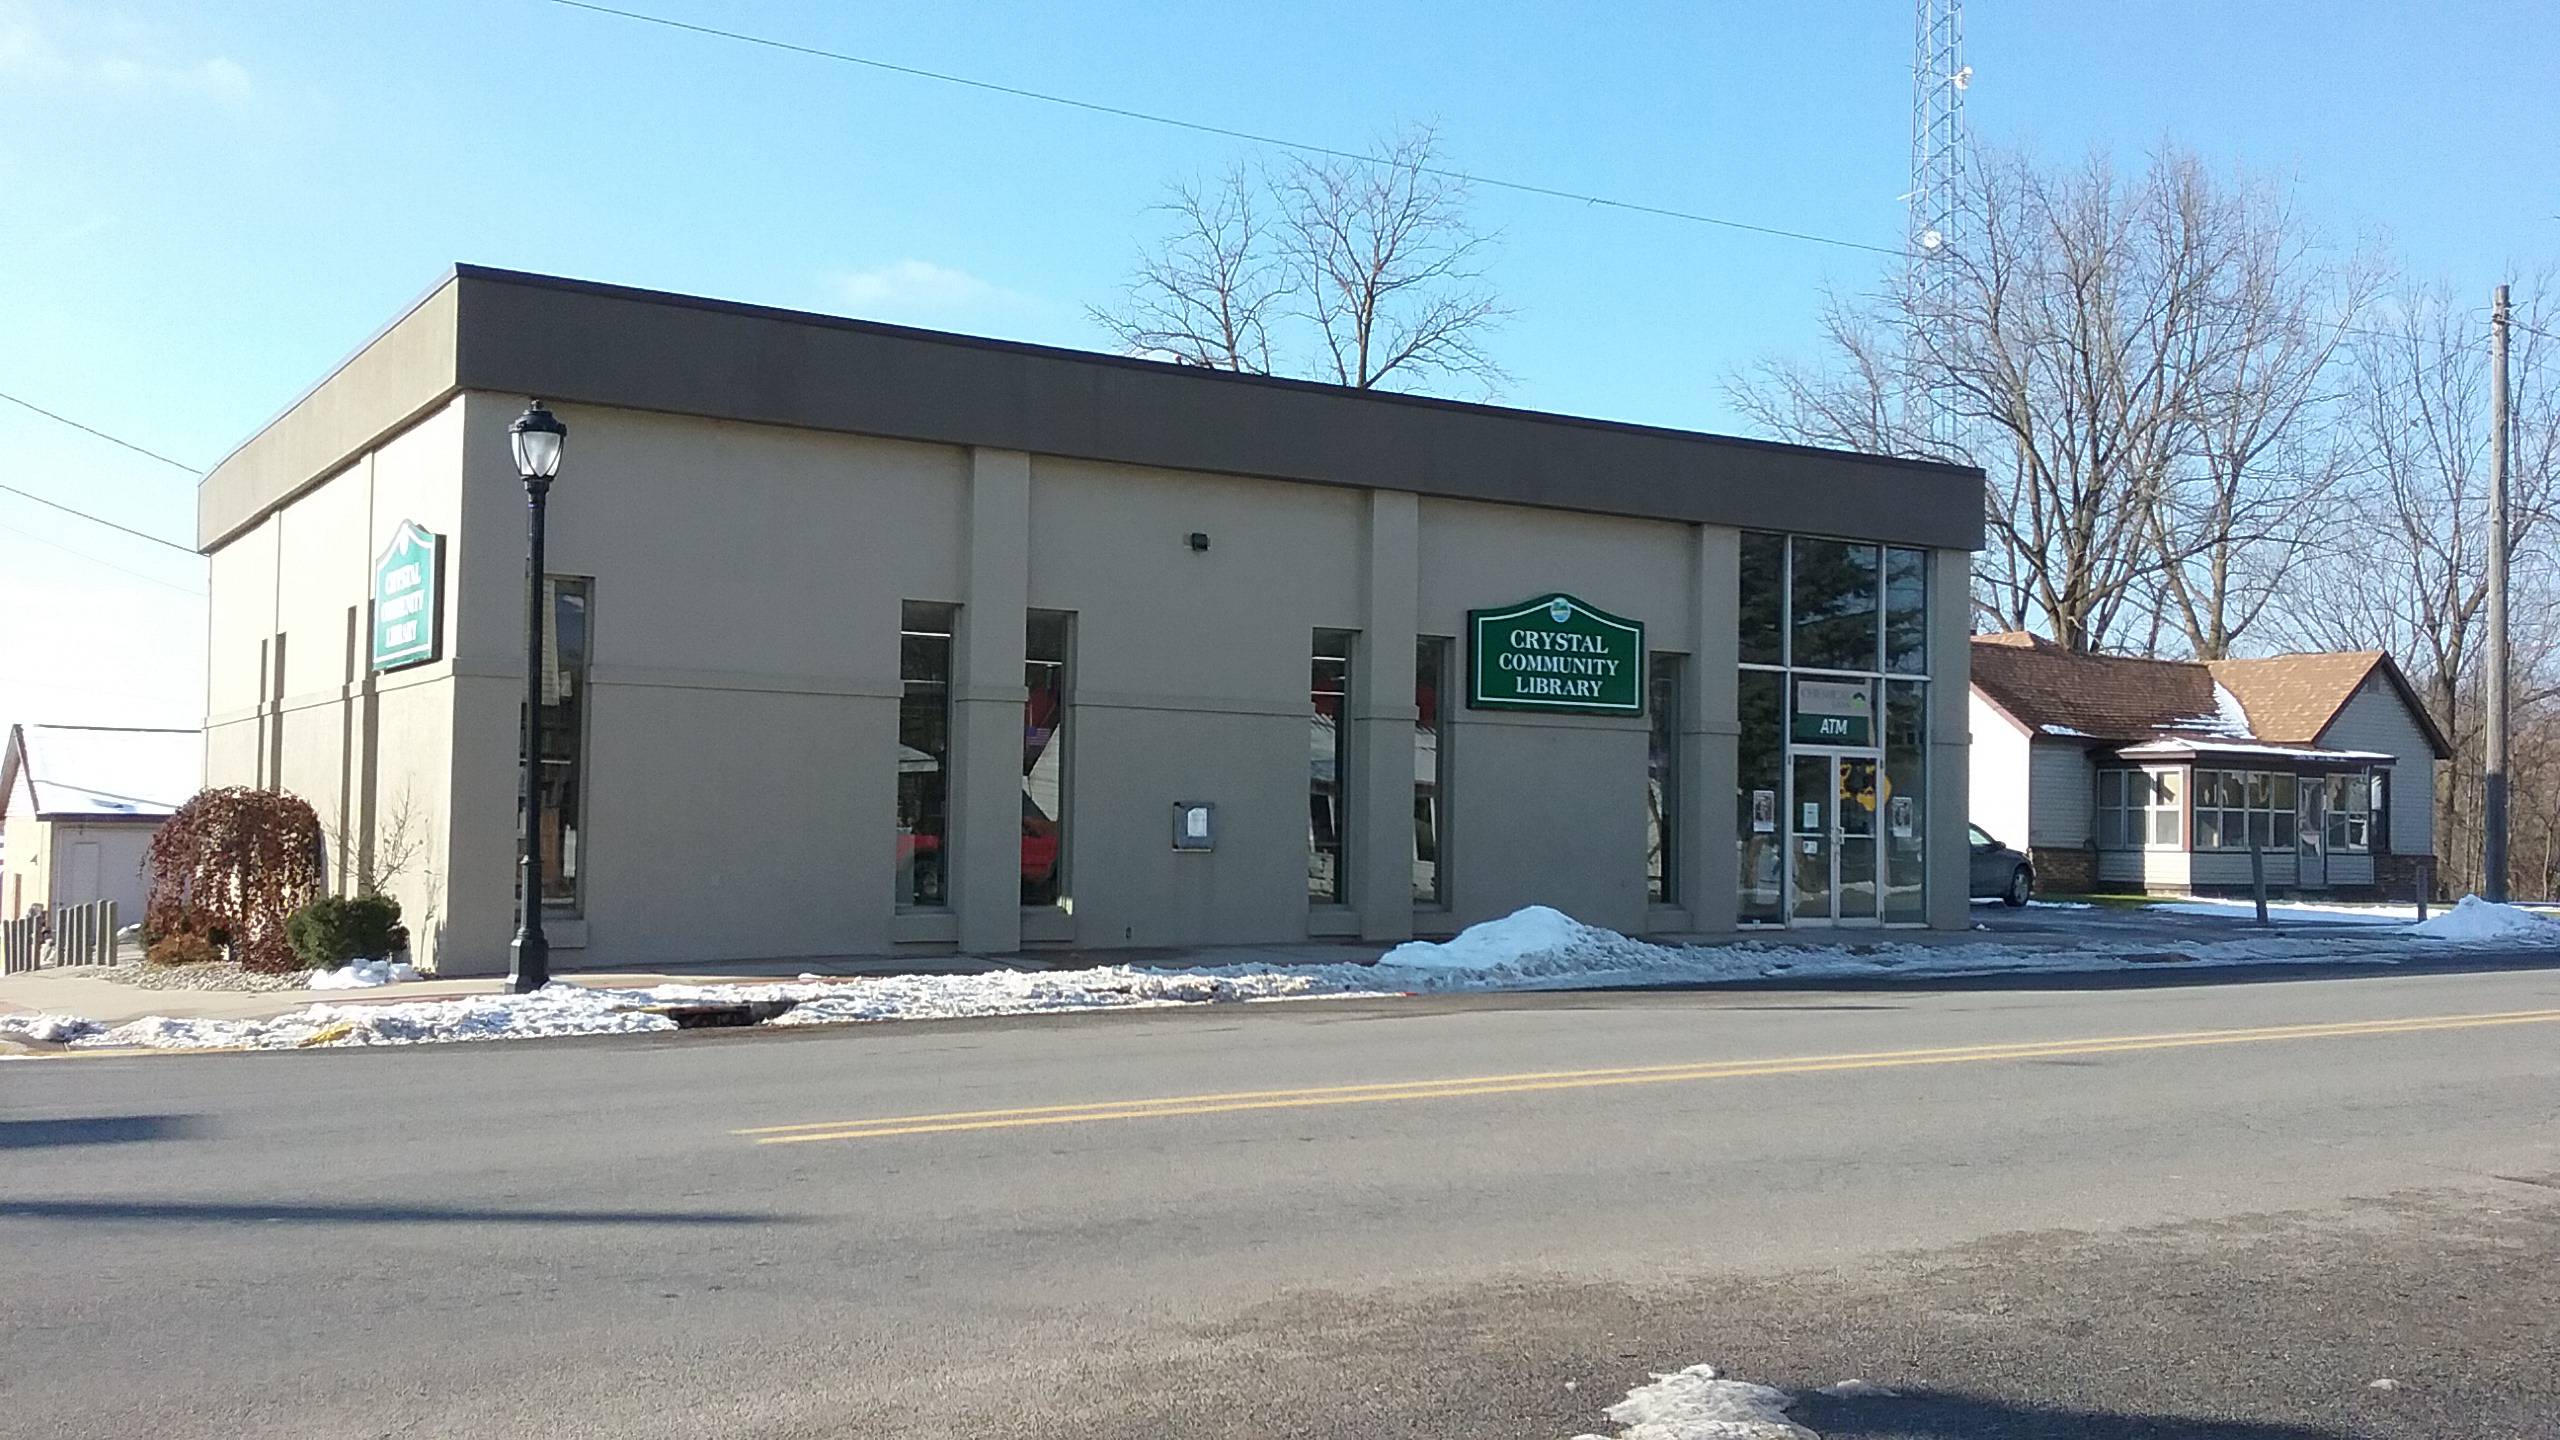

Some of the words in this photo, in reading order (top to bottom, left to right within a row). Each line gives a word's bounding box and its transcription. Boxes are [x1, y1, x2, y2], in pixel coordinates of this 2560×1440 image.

[1510, 629, 1609, 654] CRYSTAL
[1499, 652, 1619, 676] COMMUNITY
[1516, 676, 1603, 697] LIBRARY
[1819, 718, 1848, 735] ATM
